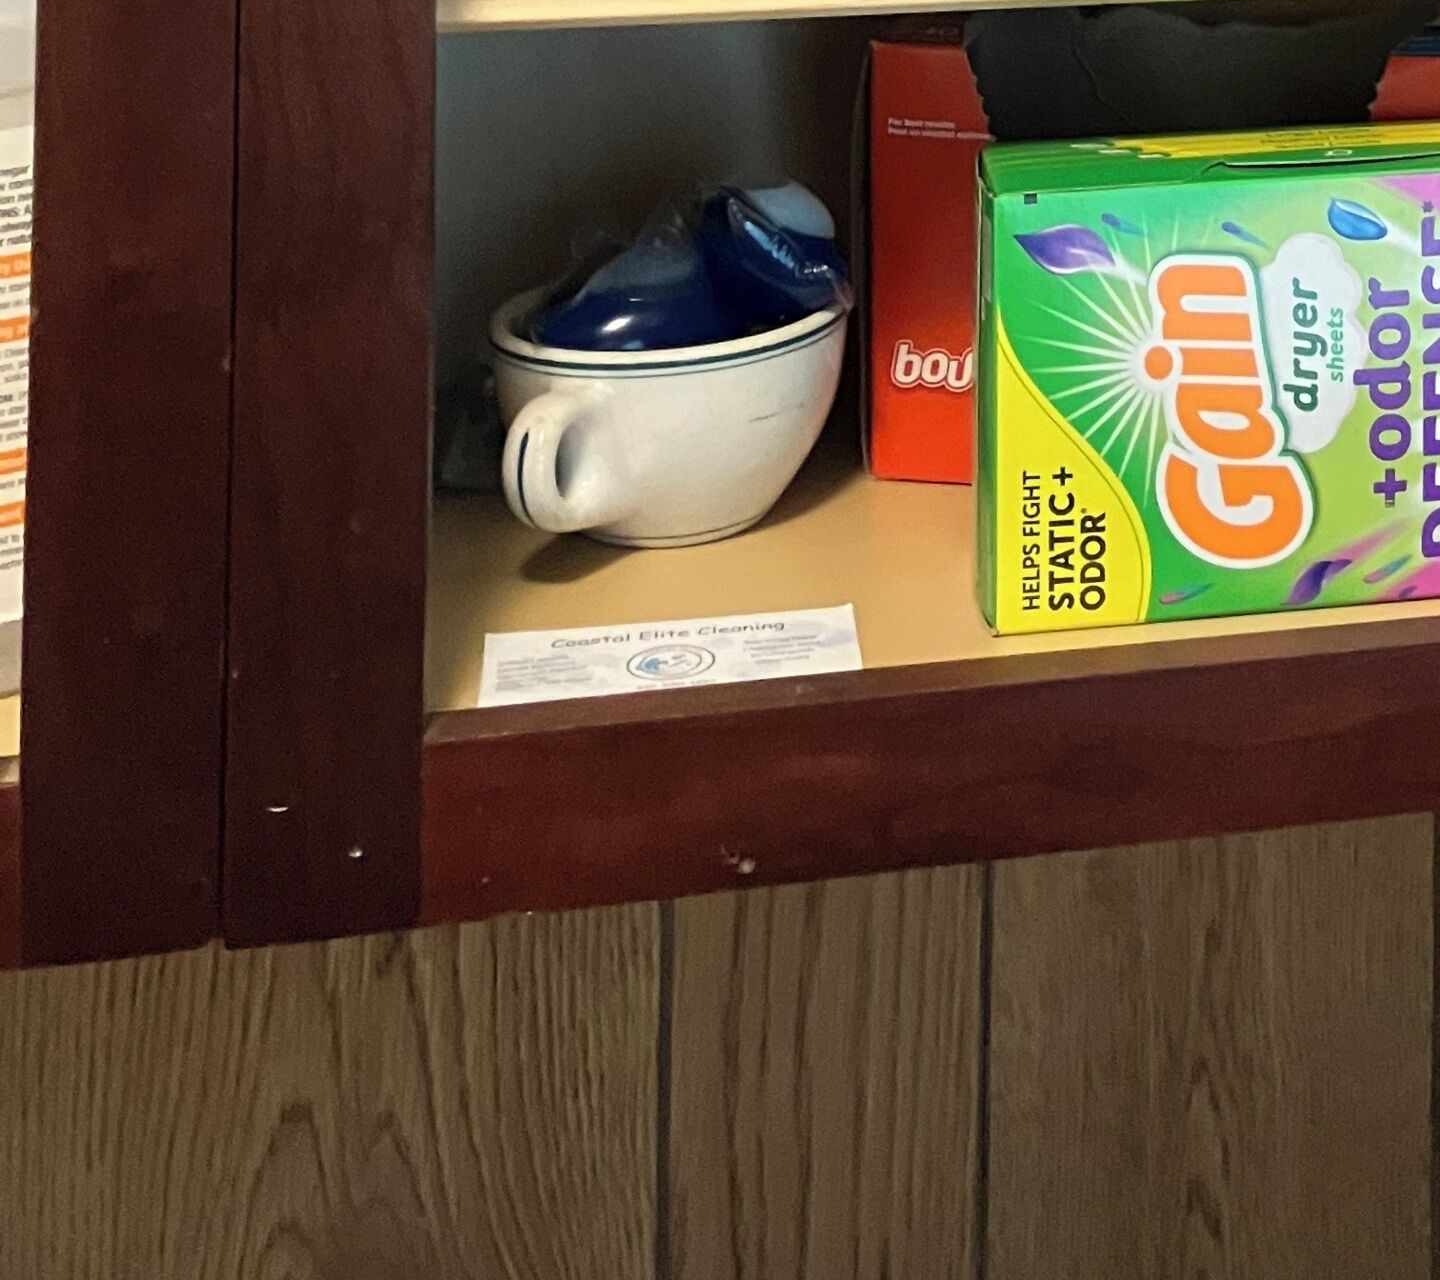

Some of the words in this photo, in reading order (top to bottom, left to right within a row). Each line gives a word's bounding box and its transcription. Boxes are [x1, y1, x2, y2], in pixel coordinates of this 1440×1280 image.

[894, 343, 974, 389] bou
[1283, 278, 1328, 412] dryer
[1326, 307, 1344, 382] sheets
[1155, 263, 1304, 560] Gain
[1022, 471, 1041, 537] FIGHT
[1022, 543, 1041, 611] HELPS
[1048, 493, 1075, 611] STATIC
[1080, 512, 1106, 611] ODOR
[551, 633, 630, 649] Coastal
[639, 629, 690, 641] Elite
[698, 621, 786, 637] Cleaning
